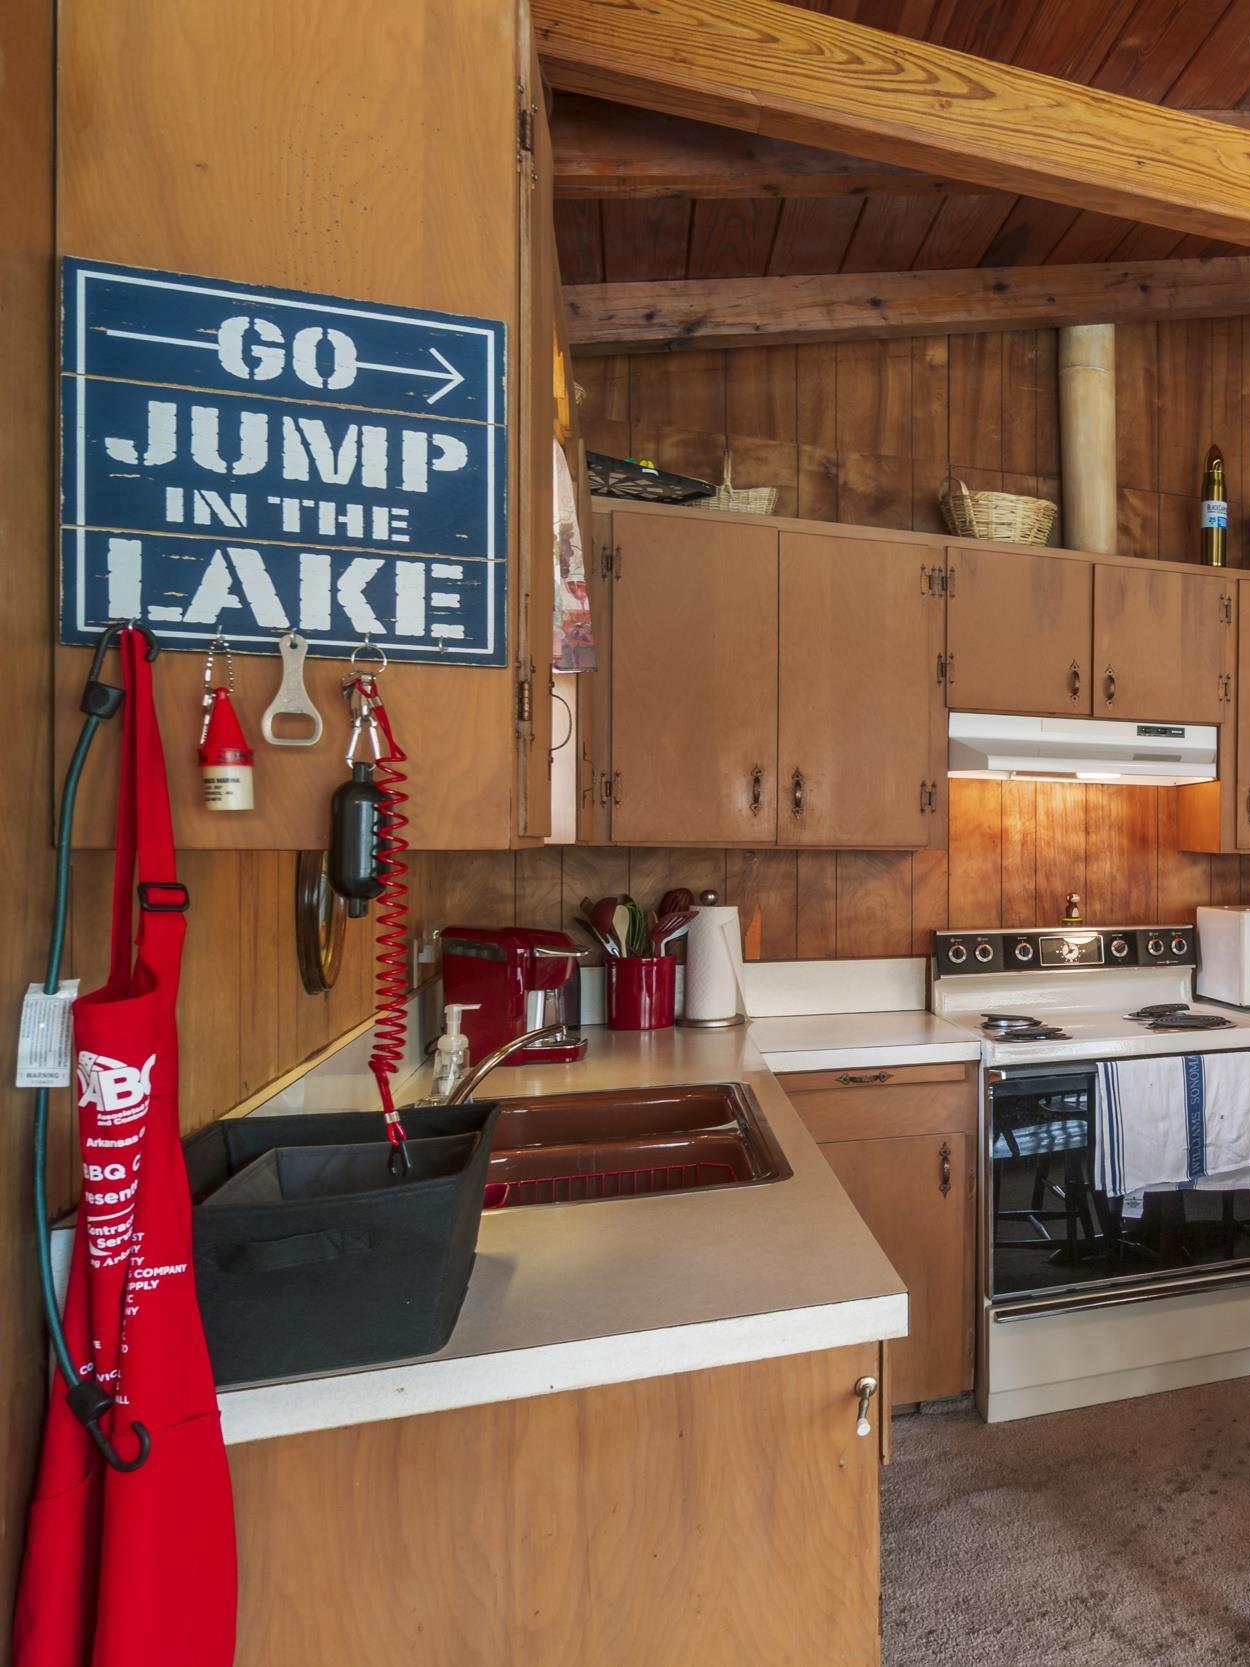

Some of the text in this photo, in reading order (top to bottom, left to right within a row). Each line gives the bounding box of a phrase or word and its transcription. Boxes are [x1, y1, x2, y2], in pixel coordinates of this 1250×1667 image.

[217, 316, 358, 390] GO
[104, 400, 469, 493] JUMP
[165, 487, 411, 542] IN THE
[107, 537, 465, 640] LAKE
[1191, 1112, 1201, 1173] WILLIAMS
[134, 1264, 187, 1278] COMPANY
